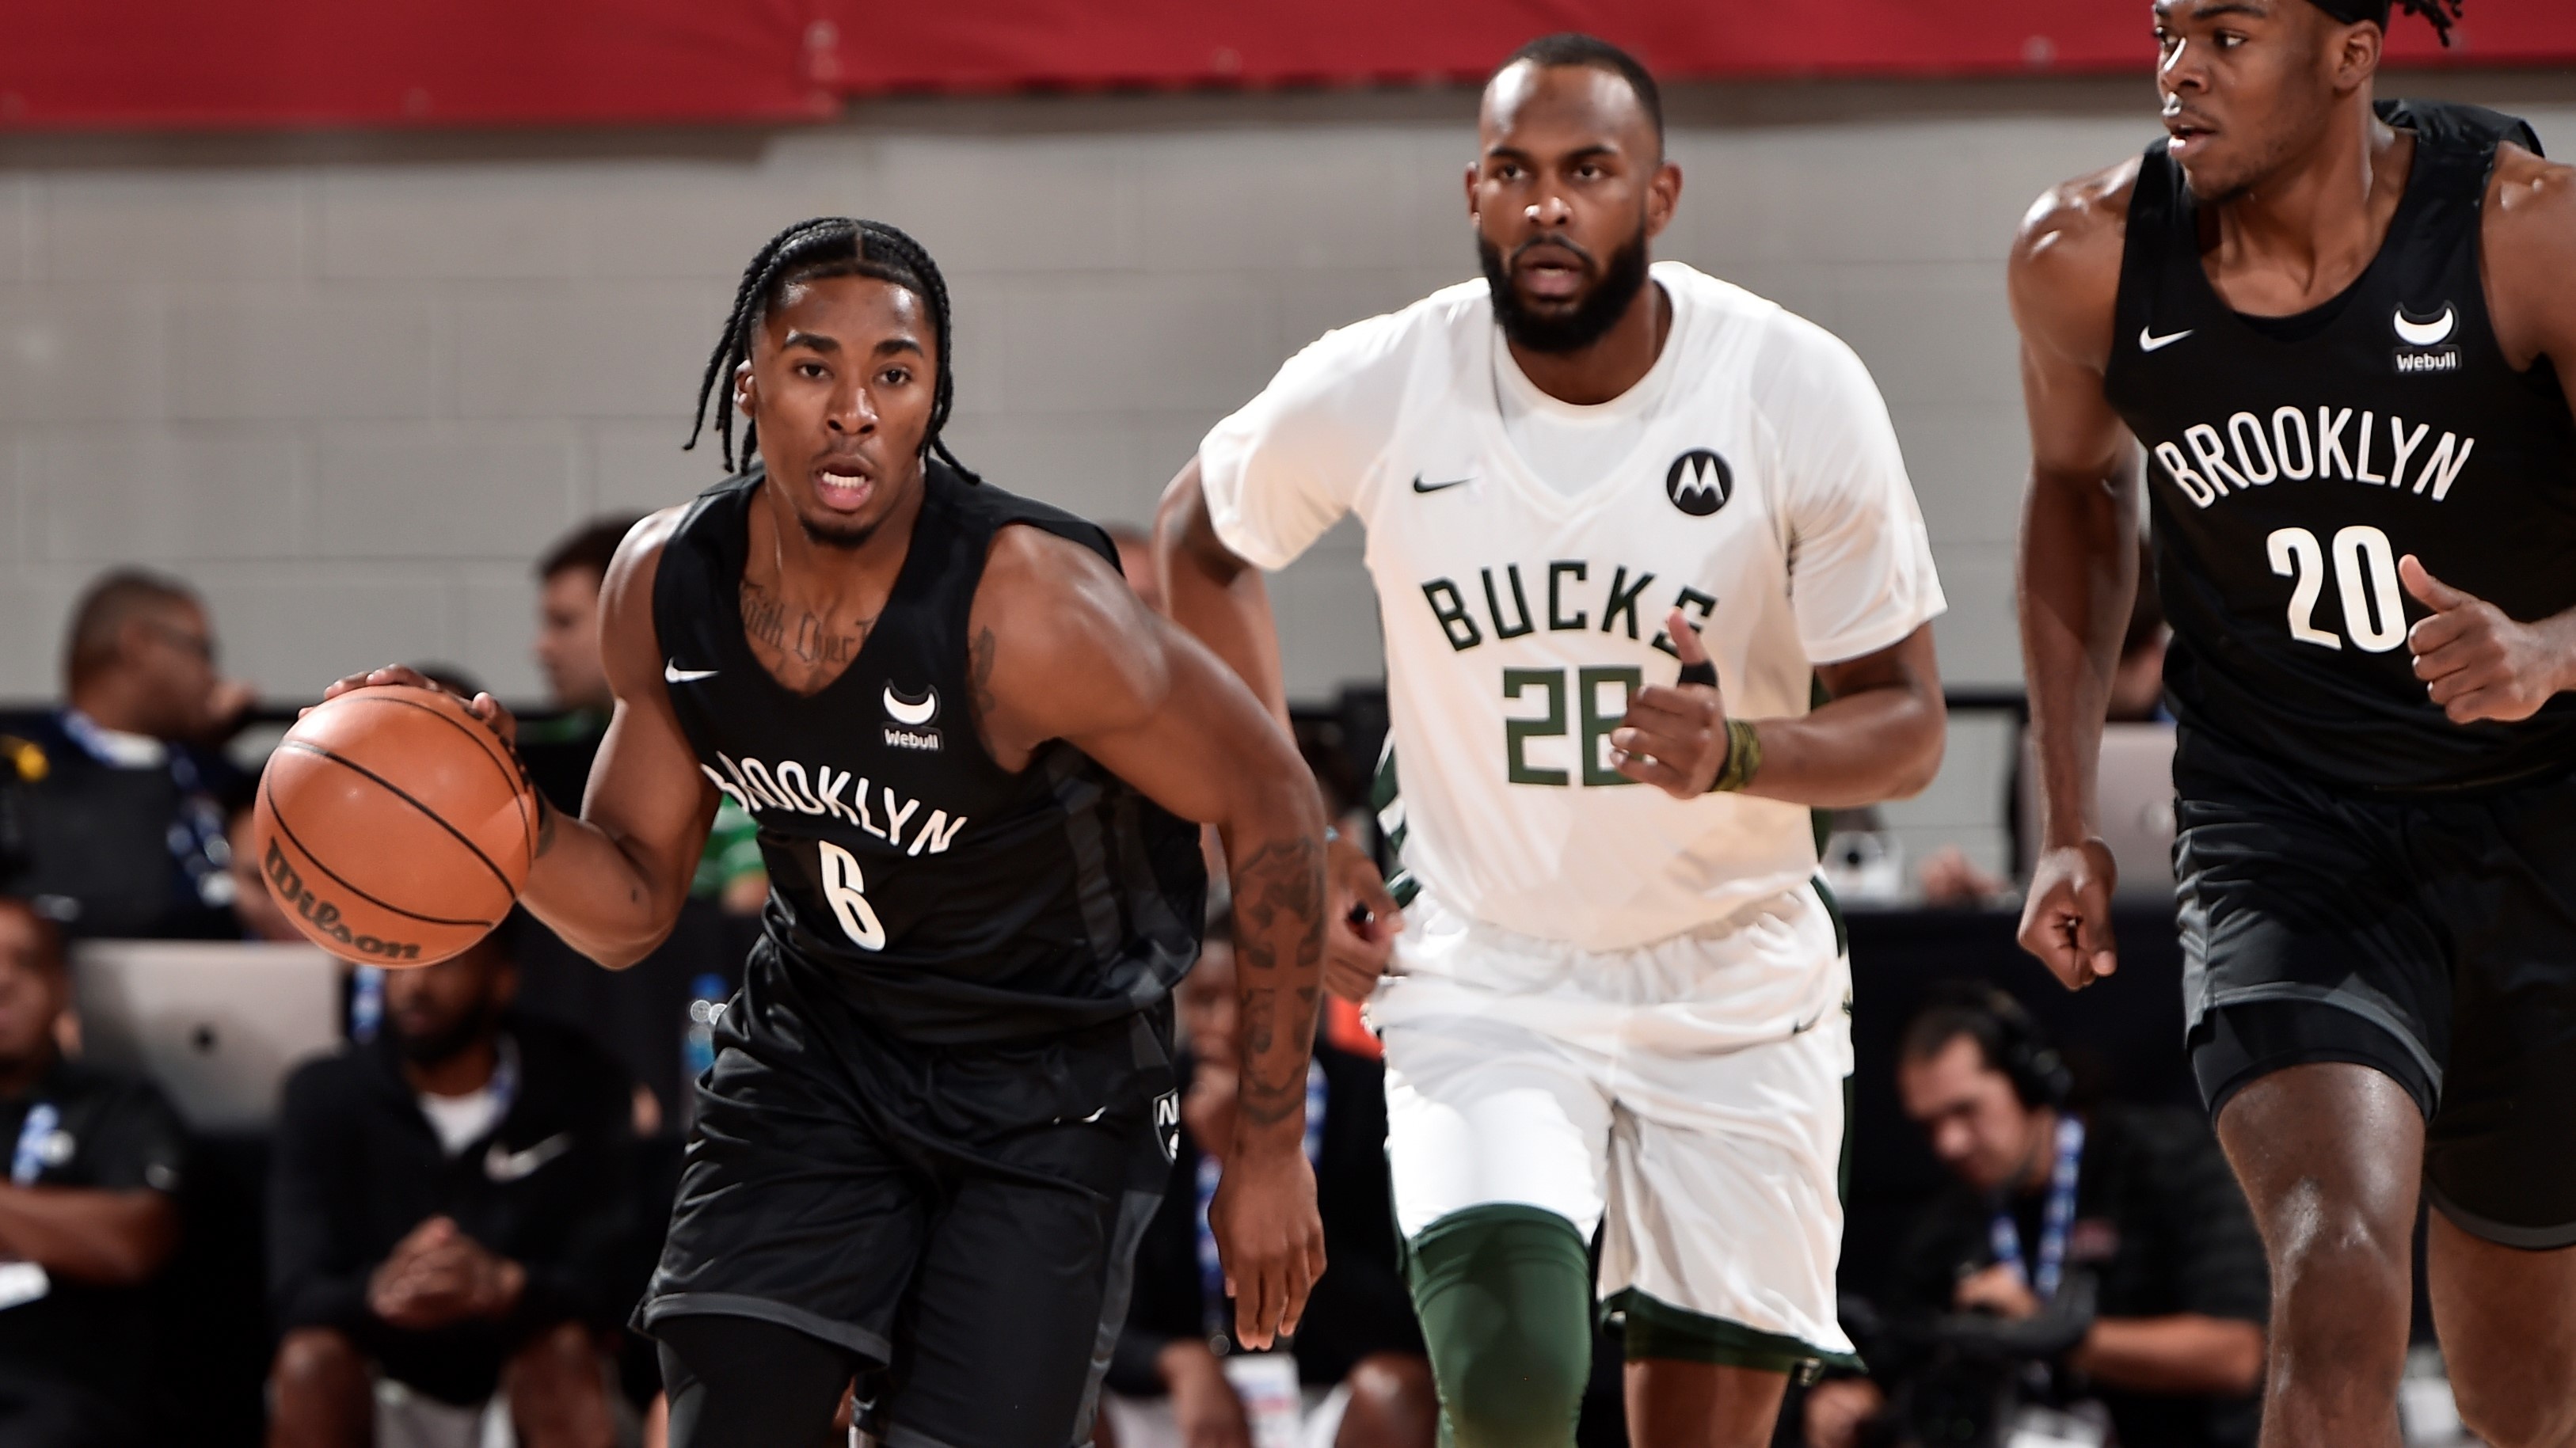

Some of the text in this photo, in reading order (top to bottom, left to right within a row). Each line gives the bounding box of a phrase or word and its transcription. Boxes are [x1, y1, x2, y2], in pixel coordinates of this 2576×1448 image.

[2396, 351, 2456, 372] Webull
[2155, 405, 2475, 509] BROOKLYN
[1421, 560, 1718, 660] BUCKS
[2266, 525, 2408, 653] 20
[884, 728, 939, 751] Webull
[266, 836, 421, 960] Wilson
[818, 839, 887, 952] 6
